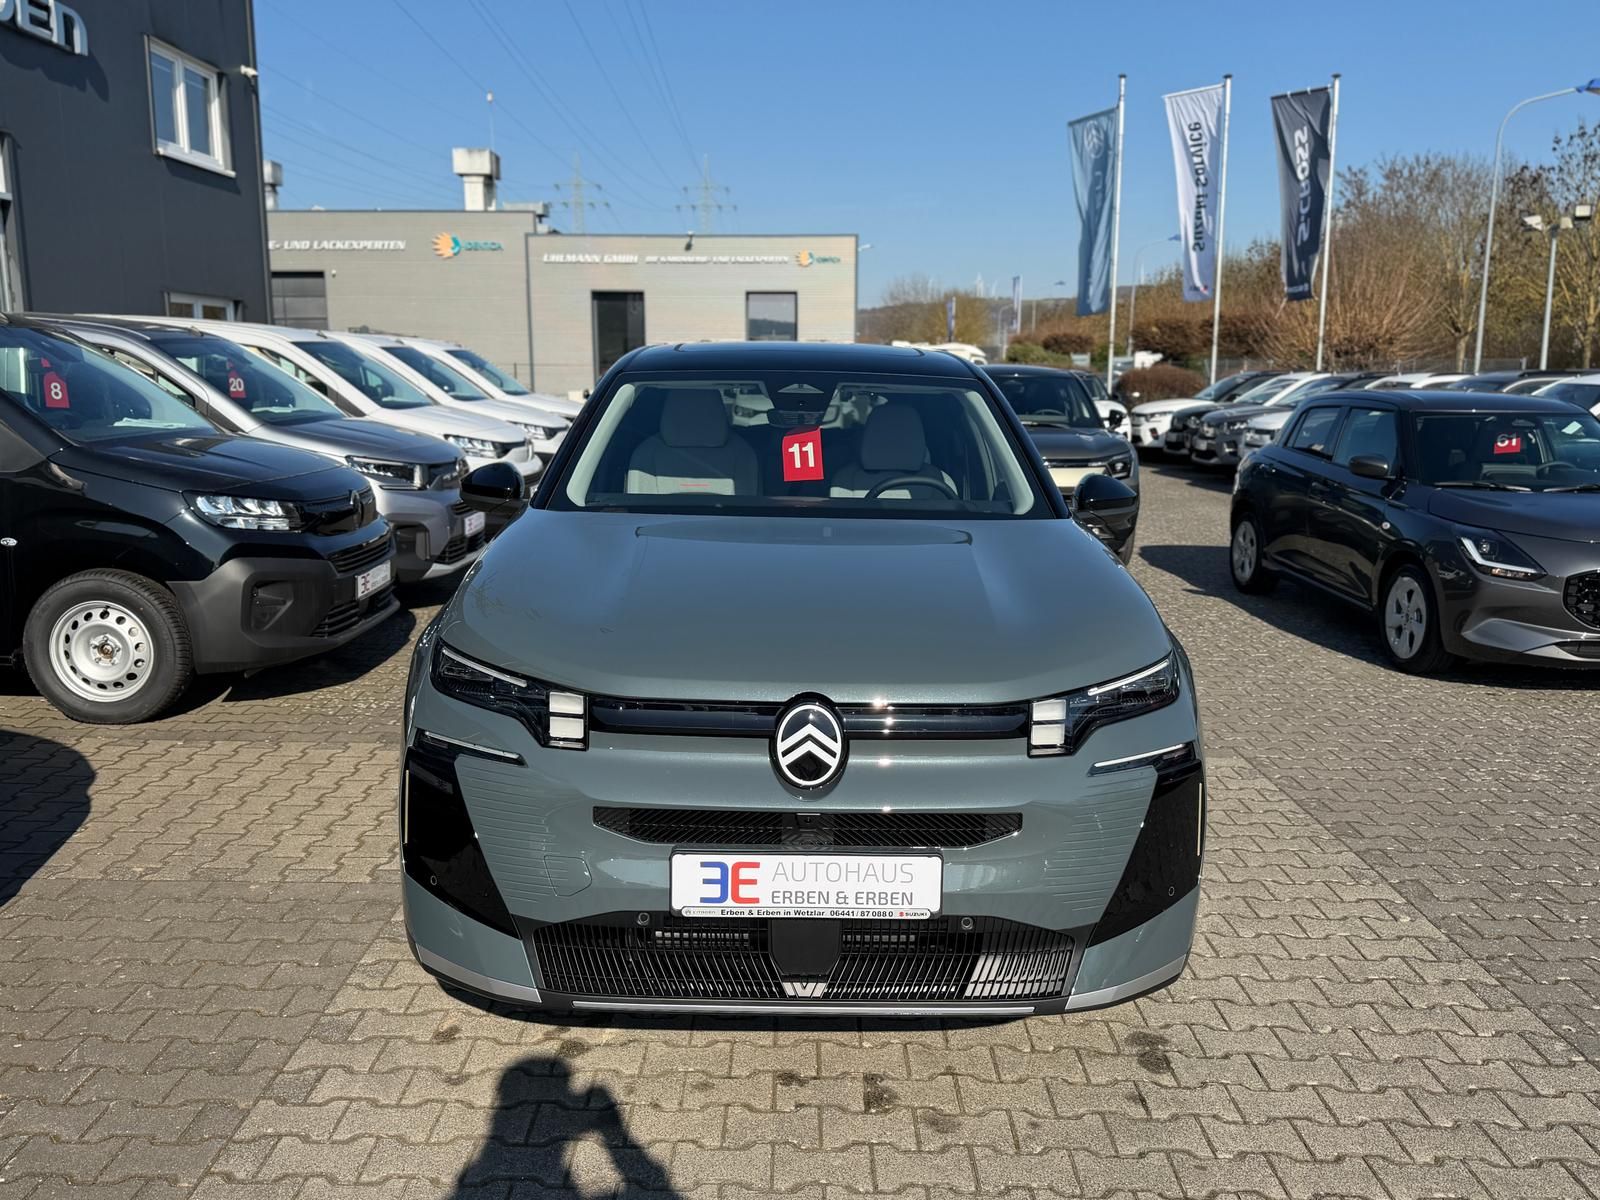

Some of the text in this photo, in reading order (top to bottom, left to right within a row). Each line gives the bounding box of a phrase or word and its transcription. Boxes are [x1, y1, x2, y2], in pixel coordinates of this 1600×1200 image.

[283, 240, 310, 250] UND
[313, 240, 406, 250] LACKEXPERTEN
[51, 382, 62, 400] 8
[229, 377, 244, 391] 20
[1497, 432, 1517, 447] 61
[788, 442, 815, 468] 11
[772, 861, 914, 884] AUTOHAUS
[771, 890, 913, 906] ERBEN & ERBEN
[794, 909, 825, 917] Wetzlar
